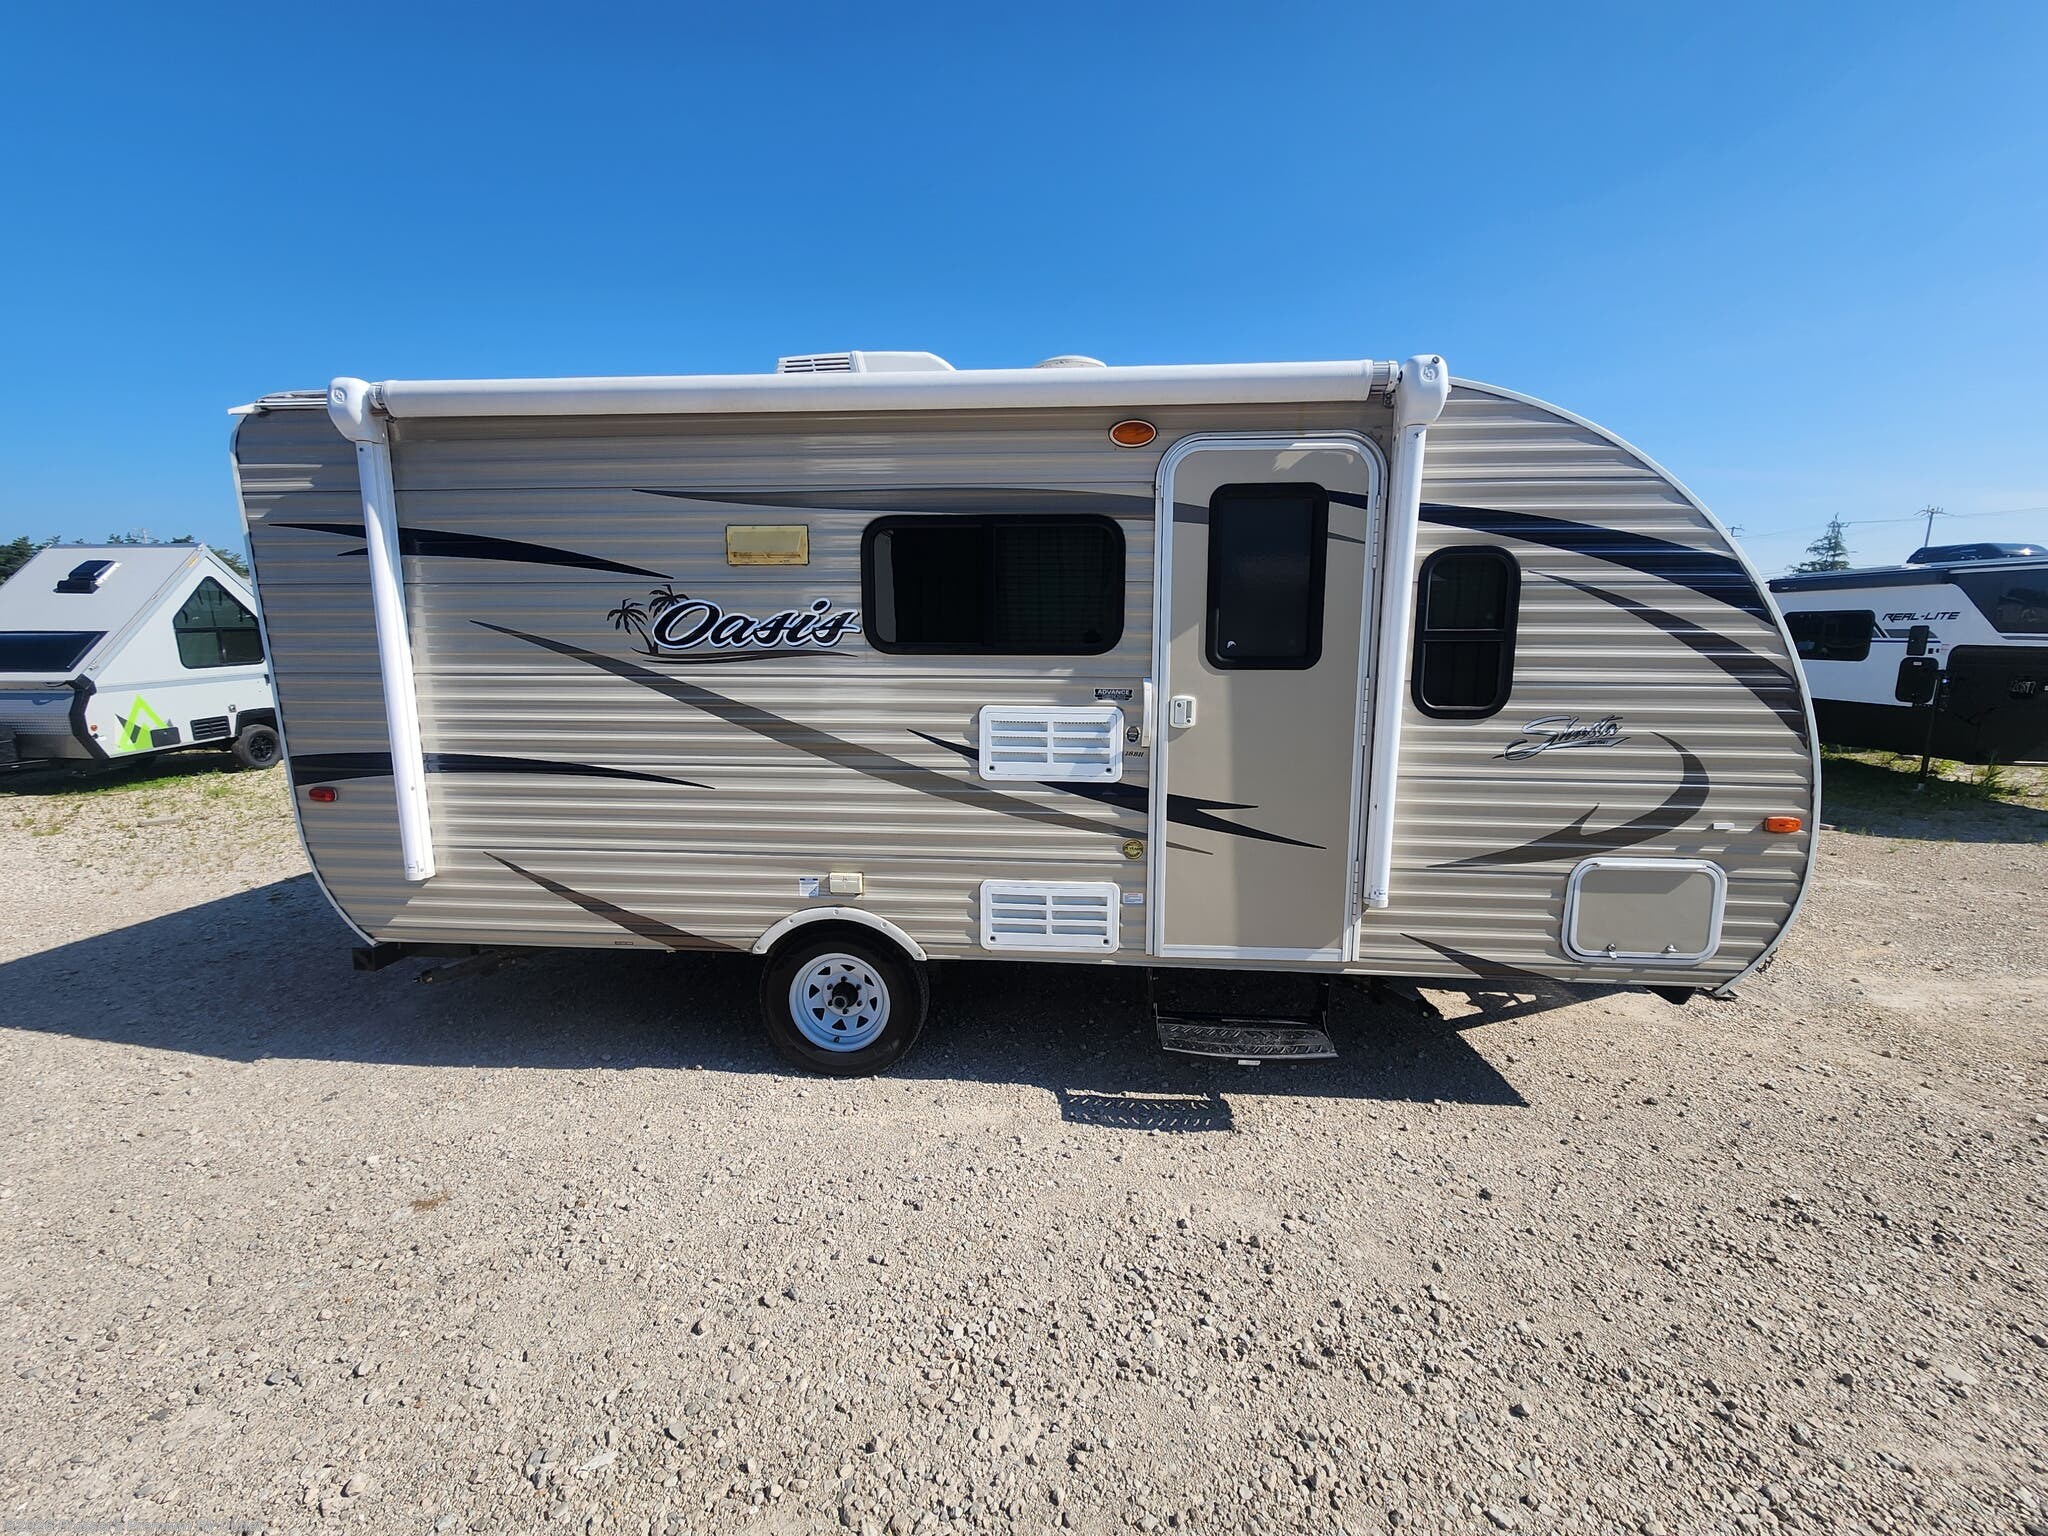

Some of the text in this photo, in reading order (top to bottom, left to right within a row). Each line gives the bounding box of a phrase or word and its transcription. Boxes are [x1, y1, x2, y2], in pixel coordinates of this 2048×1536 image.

[652, 597, 862, 649] Oasis
[1882, 611, 1961, 623] REAL-LITE
[1097, 688, 1130, 696] ADVANCE
[1503, 715, 1624, 760] Shasta
